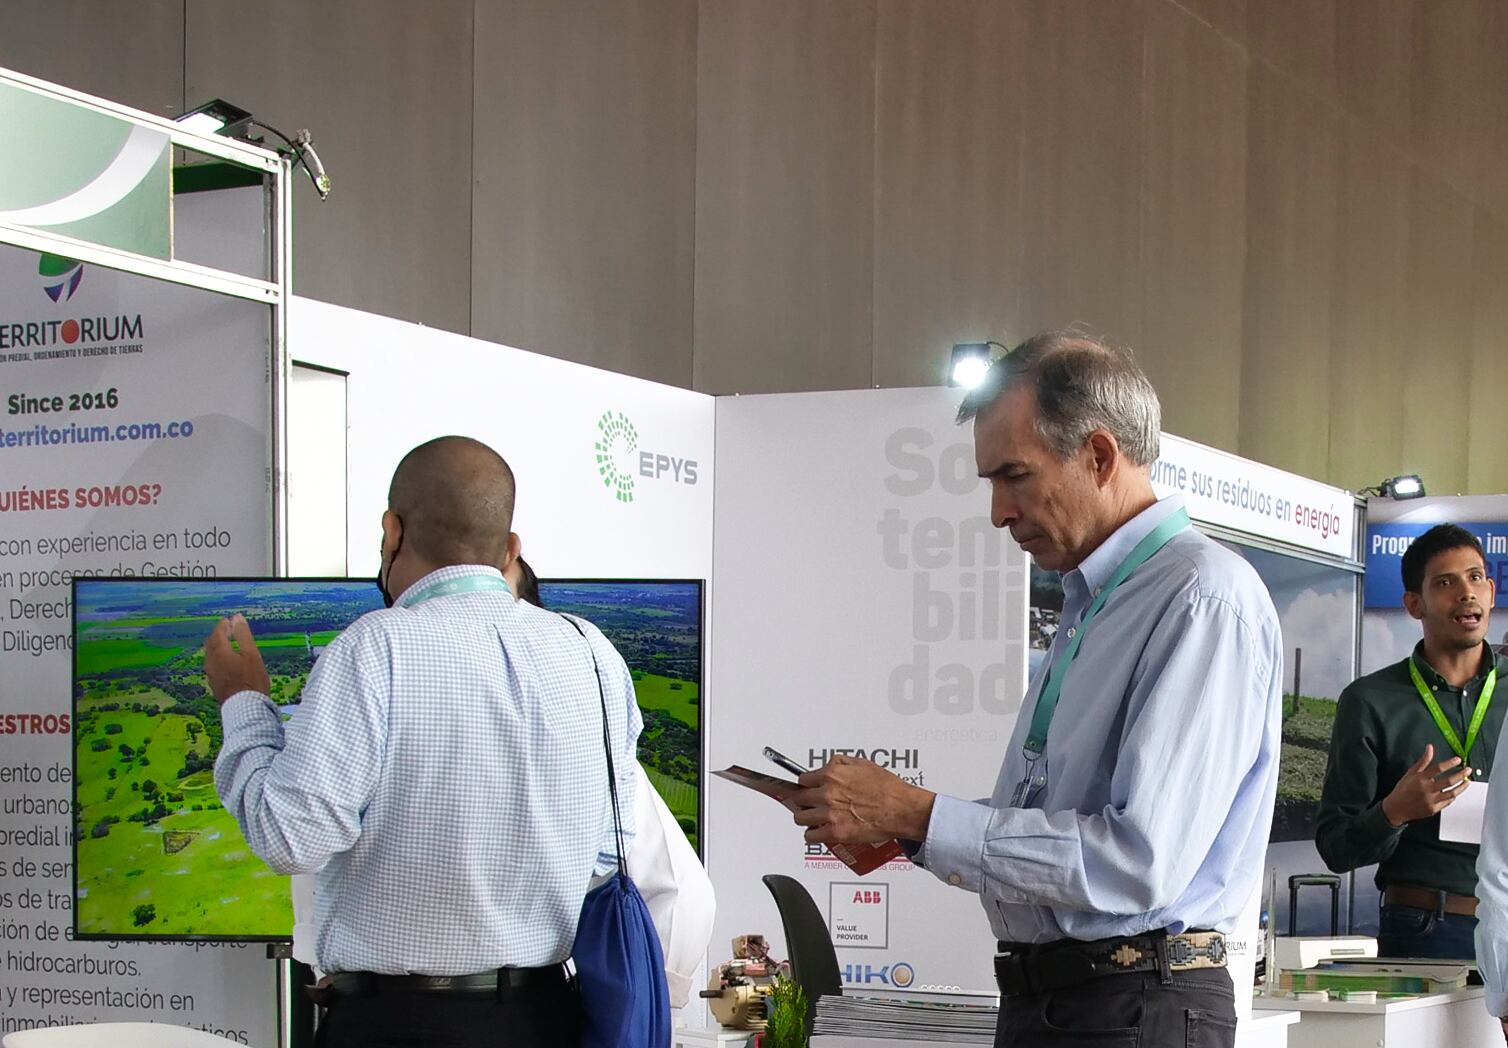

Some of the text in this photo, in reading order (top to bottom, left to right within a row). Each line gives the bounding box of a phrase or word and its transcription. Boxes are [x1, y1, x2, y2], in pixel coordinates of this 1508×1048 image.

[0, 314, 144, 349] ERRITORIUM
[8, 388, 119, 415] Since 2016
[0, 420, 194, 448] territorium.com.co
[639, 450, 698, 485] EPYS
[884, 427, 981, 497] So
[0, 484, 162, 512] UIÉNES SOMOS?
[1150, 459, 1340, 540] orme sus residuos en energía
[0, 526, 231, 559] con experiencia en todo
[10, 597, 72, 619] Derech
[913, 570, 1025, 642] bili
[3, 630, 73, 656] Diligenc
[888, 644, 1024, 716] dad
[0, 714, 71, 734] STROS
[0, 762, 71, 783] ento de
[4, 794, 74, 815] urbano
[12, 857, 36, 877] de
[18, 888, 42, 909] de
[48, 889, 72, 910] tra
[852, 890, 881, 904] ABB
[35, 920, 60, 941] de
[836, 933, 869, 941] PROVIDER
[1226, 942, 1247, 952] RIUM
[7, 951, 142, 977] hidrocarburos.
[840, 962, 915, 988] HIKO
[6, 986, 194, 1011] y representación en
